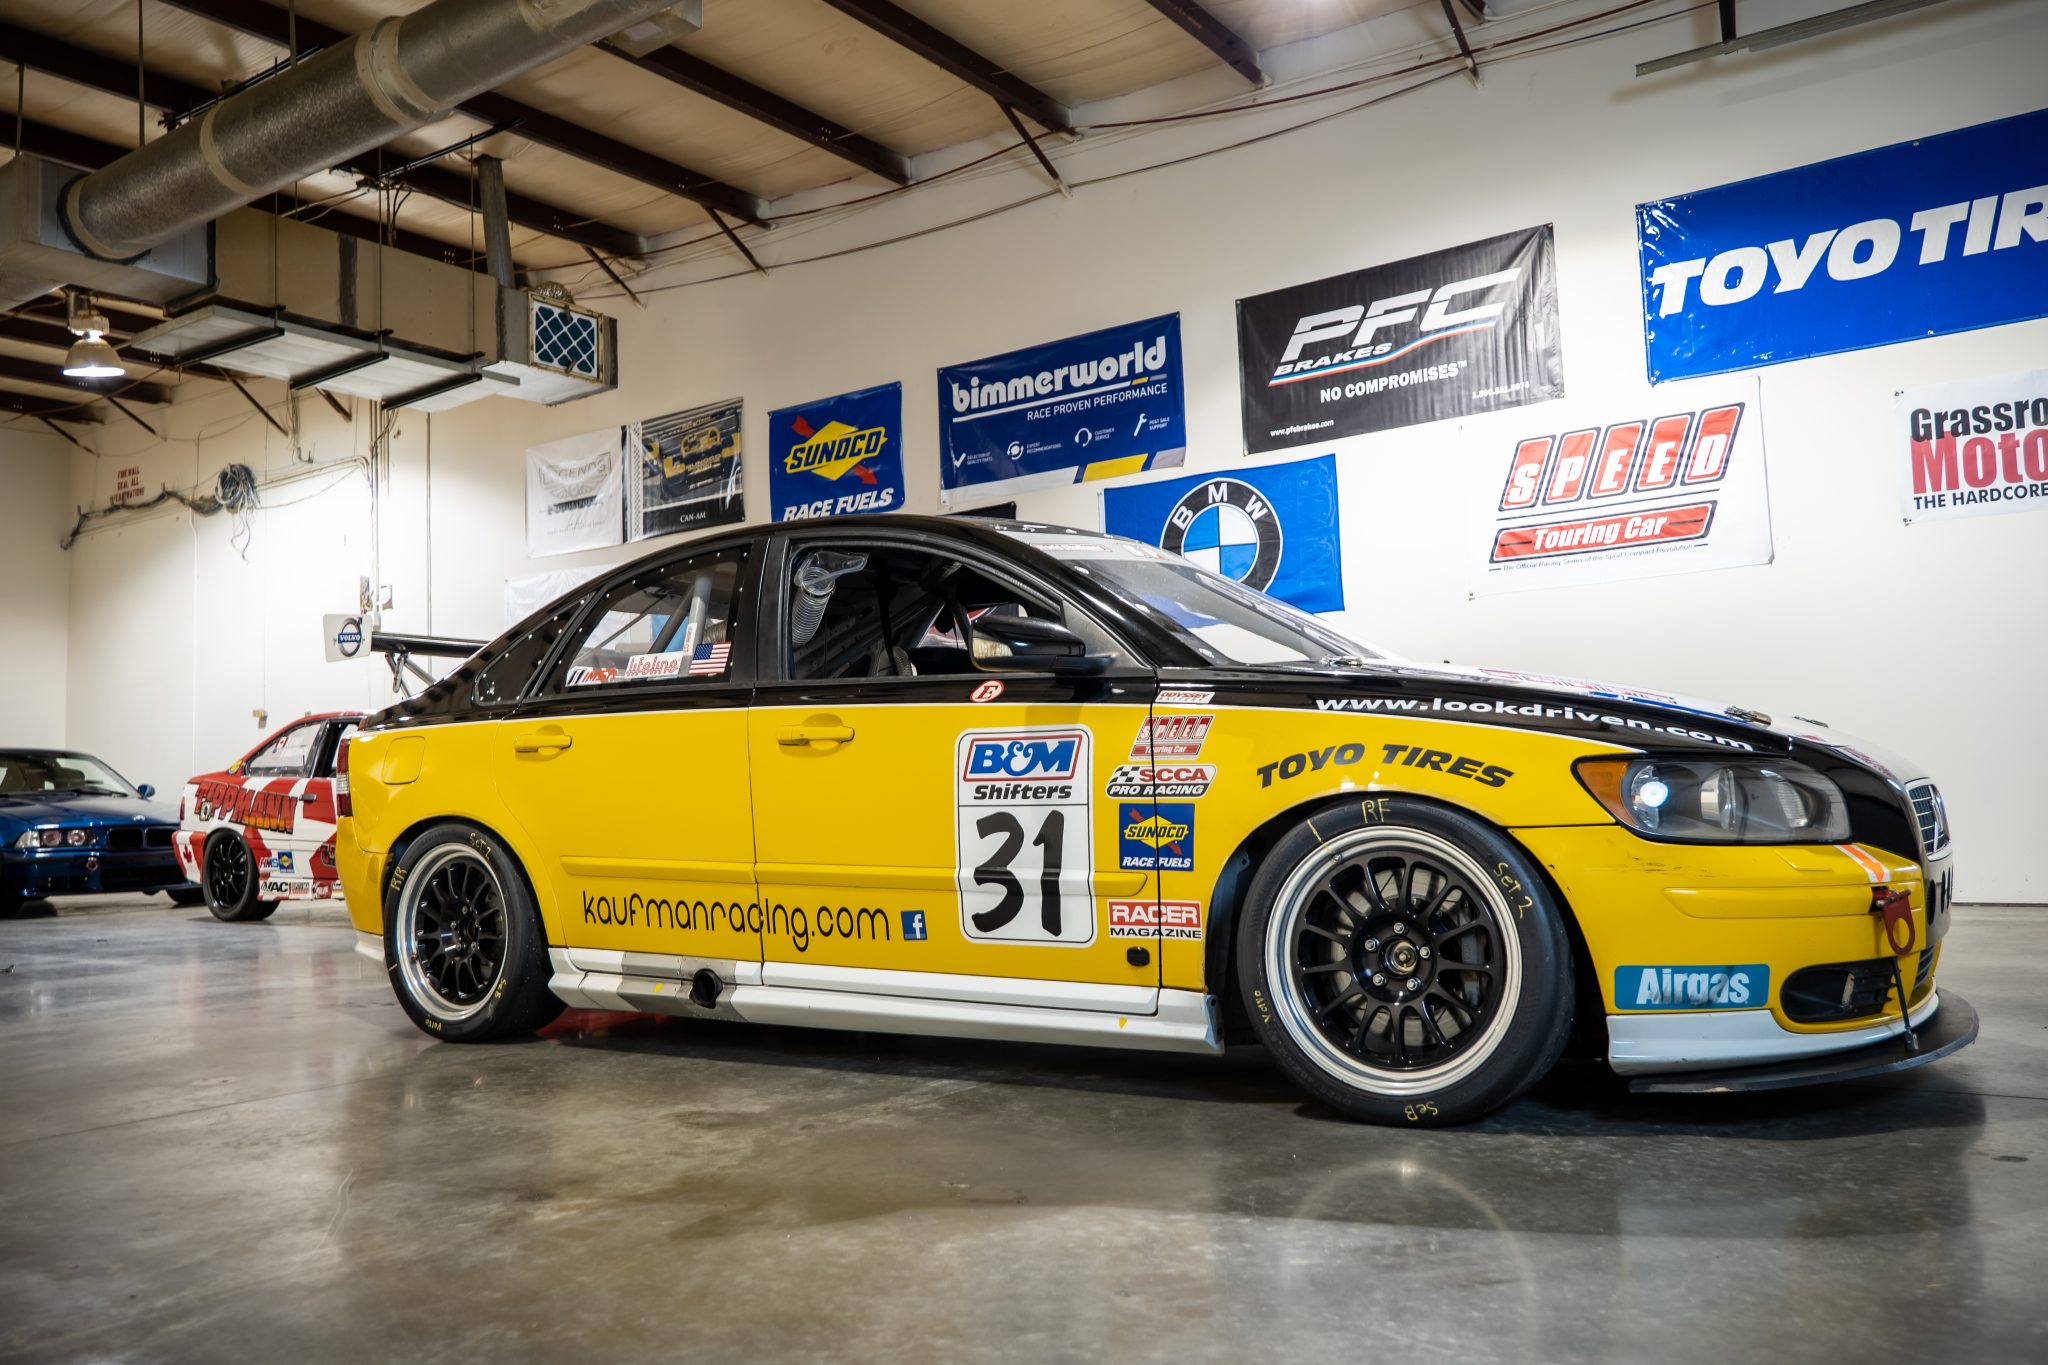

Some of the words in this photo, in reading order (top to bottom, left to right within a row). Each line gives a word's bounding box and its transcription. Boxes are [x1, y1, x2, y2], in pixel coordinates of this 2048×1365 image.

[1653, 218, 1901, 317] TOYO
[1910, 185, 2048, 265] TIR
[1280, 267, 1523, 363] PFC
[1273, 342, 1392, 377] BRAKES
[952, 336, 1167, 412] bimmerworld
[1027, 406, 1051, 421] RACE
[1053, 399, 1091, 417] PROVEN
[1094, 382, 1168, 407] PERFORMANCE
[1320, 387, 1342, 403] NO
[1095, 428, 1115, 436] CUSTOMER
[1270, 420, 1334, 437] www.pfcbrakes.com
[790, 434, 883, 473] SUNOCO
[1505, 430, 1732, 505] SPEED
[783, 498, 834, 521] RACE
[835, 487, 894, 514] FUELS
[1172, 482, 1268, 530] BMW
[1913, 493, 1946, 510] THE
[1952, 482, 2048, 506] HARDCORE
[680, 511, 706, 523] CAN-AM
[1533, 521, 1622, 551] Touring
[1624, 515, 1669, 538] Car
[1515, 562, 1537, 570] Official
[1539, 560, 1561, 568] Racing
[1563, 557, 1583, 565] Series
[1605, 553, 1623, 562] Sport
[1625, 549, 1655, 558] Compact
[1656, 544, 1693, 554] Revolution
[626, 655, 679, 677] lifeline
[975, 685, 999, 699] E
[1141, 724, 1207, 740] SPEED
[1316, 698, 1755, 752] www.lookdriven.com
[969, 739, 1076, 777] B&M
[1145, 745, 1173, 754] Touring
[1139, 767, 1208, 782] SCCA
[1257, 743, 1365, 789] TOYO
[1382, 743, 1515, 788] TIRES
[974, 783, 1072, 800] Shifters
[1109, 785, 1143, 795] PRO
[1144, 784, 1205, 795] RACING
[194, 780, 299, 834] TIPPMANN
[1361, 798, 1391, 824] RF
[1127, 825, 1186, 839] SUNOCO
[971, 809, 1065, 937] 31
[1122, 856, 1154, 868] RACE
[1158, 857, 1192, 868] FUELS
[390, 866, 408, 891] RR
[1111, 904, 1198, 924] RACER
[1519, 895, 1533, 919] 2
[583, 890, 890, 952] kaufmanracing.com
[1110, 927, 1202, 939] MAGAZINE
[1636, 968, 1750, 1008] Airgas
